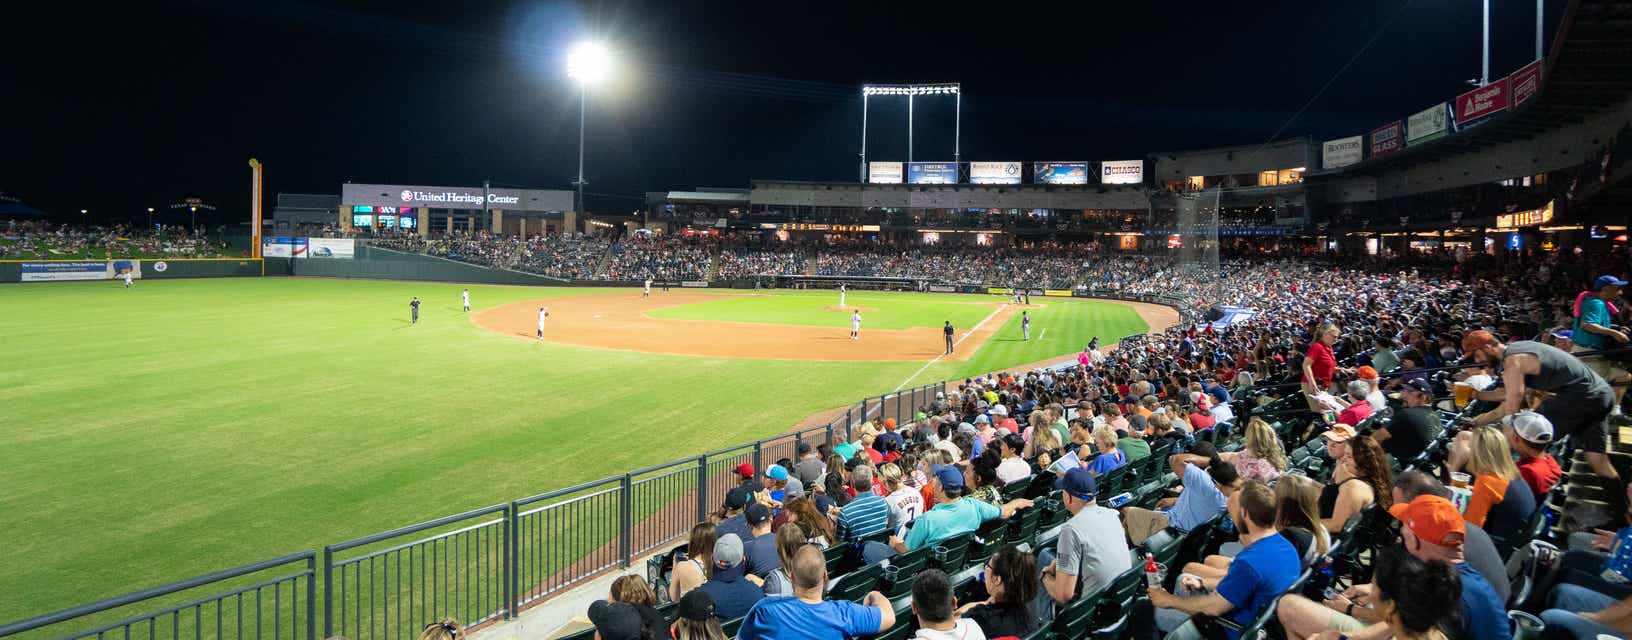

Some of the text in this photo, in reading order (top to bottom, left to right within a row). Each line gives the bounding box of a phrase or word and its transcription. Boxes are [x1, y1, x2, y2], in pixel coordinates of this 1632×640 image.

[1373, 140, 1397, 153] GLASS
[1112, 166, 1140, 175] CHASCO
[414, 191, 519, 205] United Heritag Center
[907, 507, 915, 521] 7
